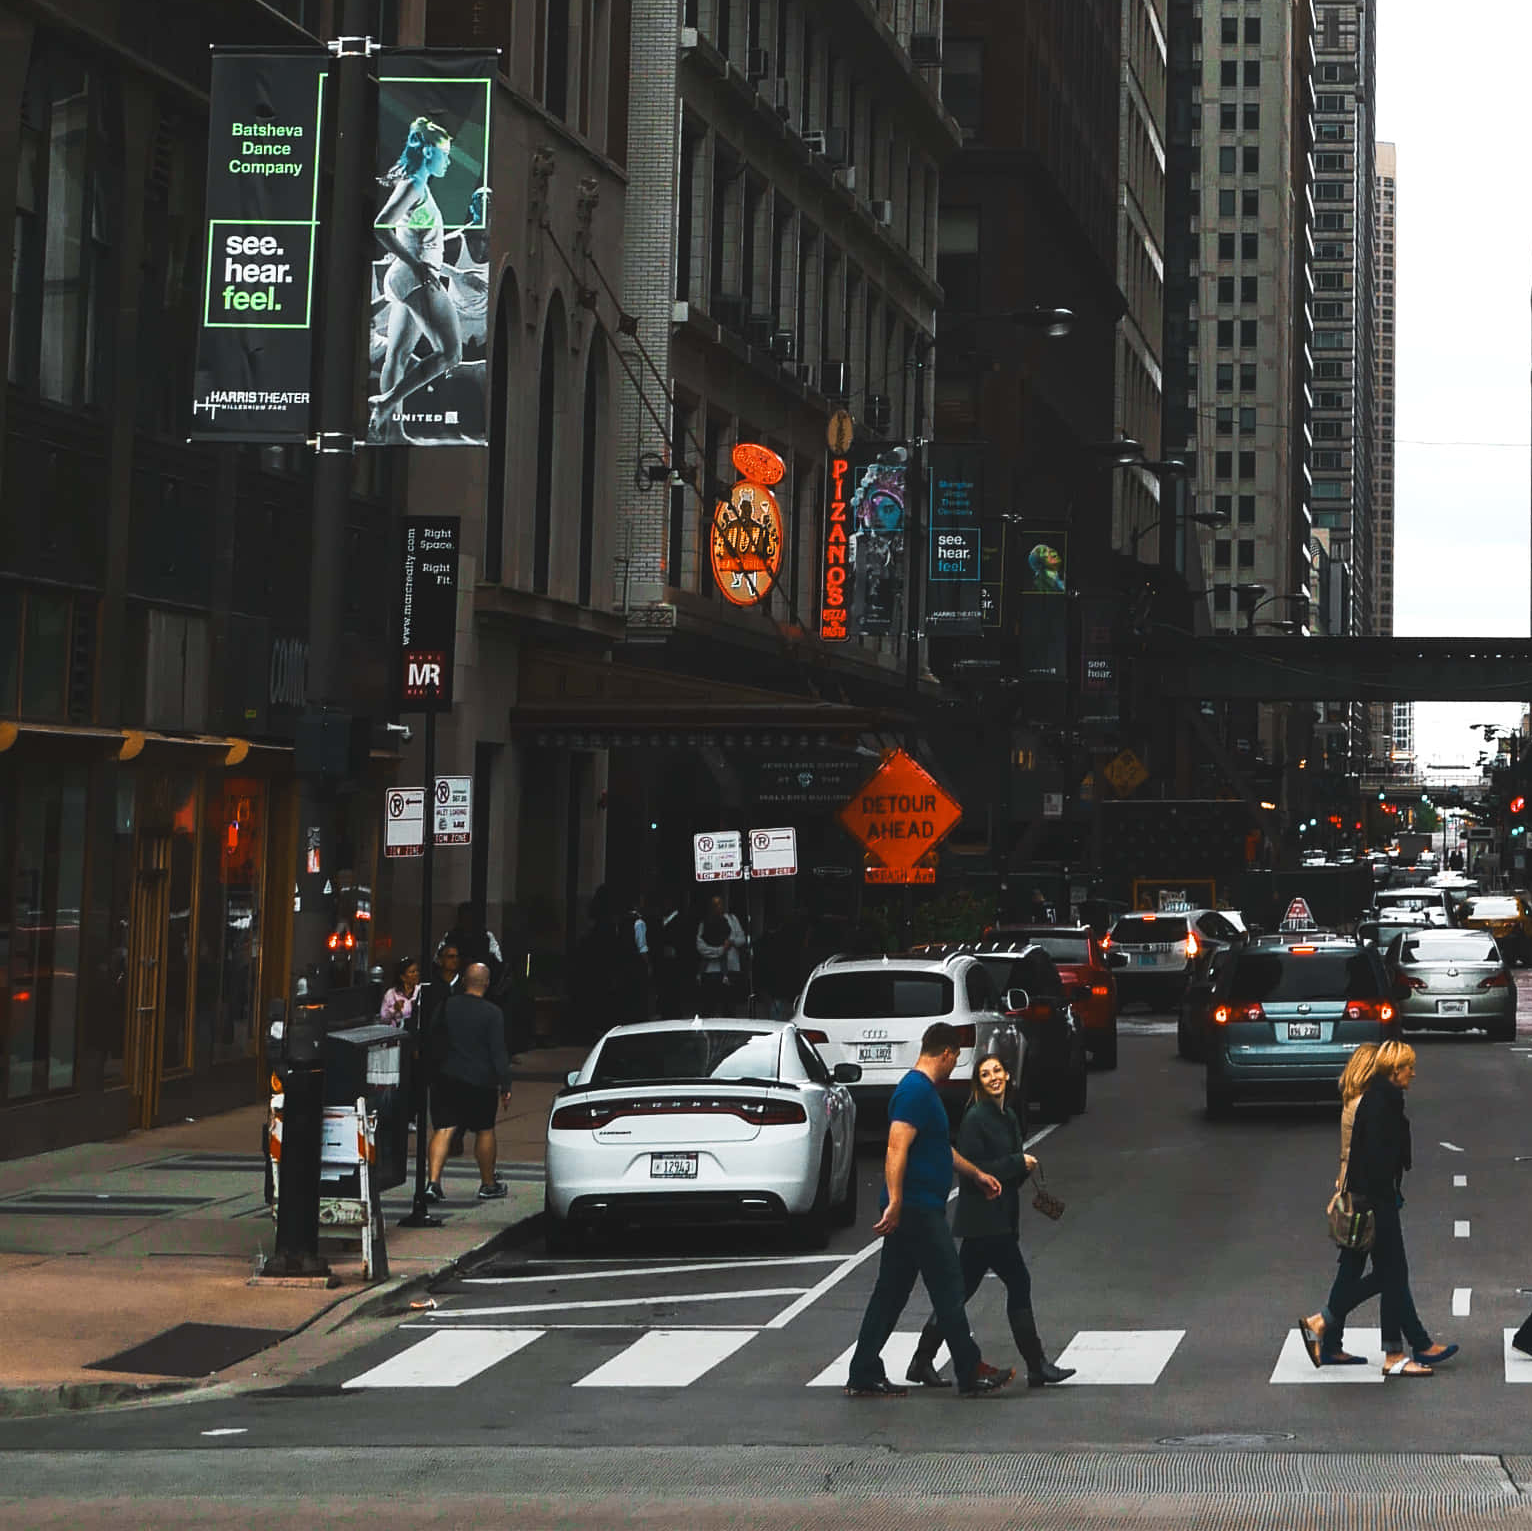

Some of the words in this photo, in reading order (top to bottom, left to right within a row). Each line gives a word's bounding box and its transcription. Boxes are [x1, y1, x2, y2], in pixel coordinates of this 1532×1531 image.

[232, 122, 303, 137] Batsheva
[241, 141, 291, 155] Dance
[228, 160, 303, 176] Company
[225, 234, 285, 255] see.
[224, 257, 293, 284] hear.
[222, 285, 282, 311] feel.
[392, 413, 443, 422] UNITED
[424, 528, 452, 539] Right
[937, 534, 967, 546] see.
[419, 540, 455, 551] Space.
[937, 546, 971, 560] hear.
[422, 563, 451, 574] Right
[937, 560, 967, 573] feel.
[436, 575, 453, 586] Fit.
[863, 795, 936, 814] DETOUR
[866, 820, 934, 839] AHEAD
